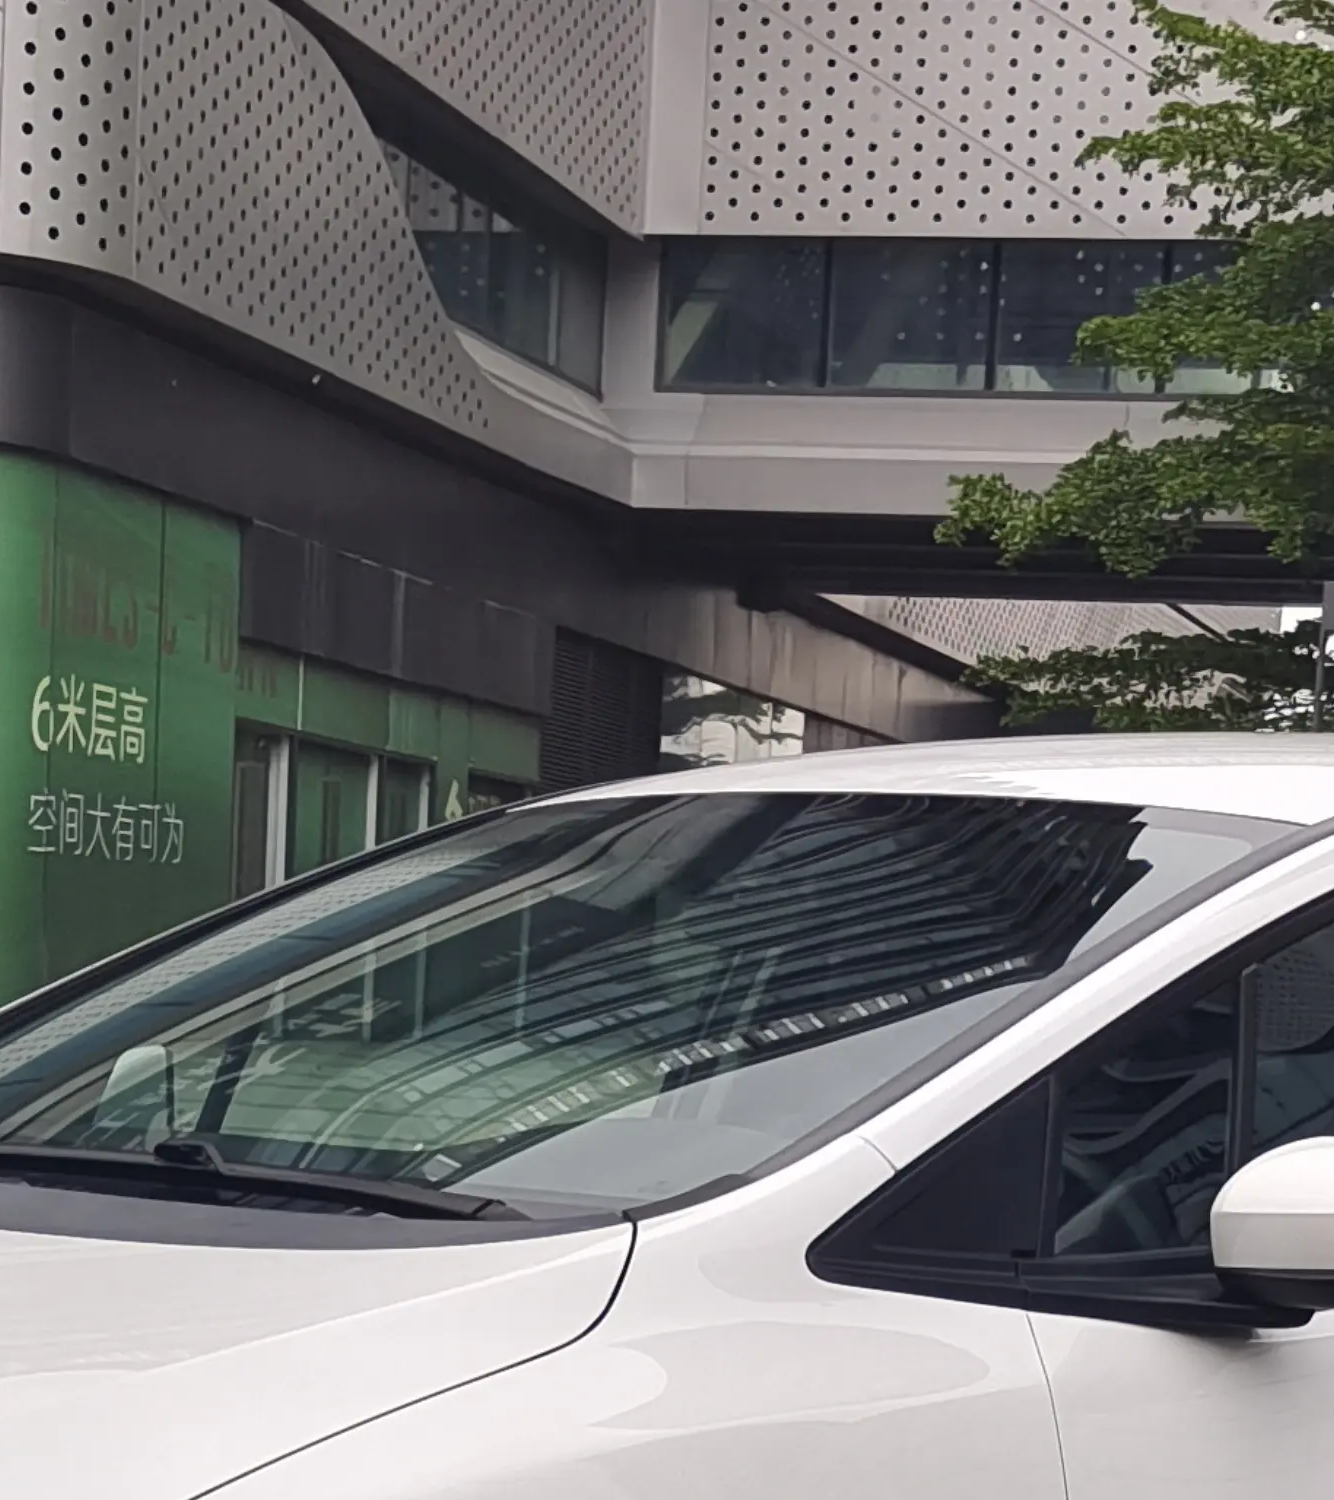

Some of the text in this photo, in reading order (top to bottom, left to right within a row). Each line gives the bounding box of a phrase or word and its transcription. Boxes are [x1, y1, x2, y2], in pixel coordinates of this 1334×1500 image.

[31, 673, 149, 764] 6米层高
[26, 787, 185, 865] 空间大有可为
